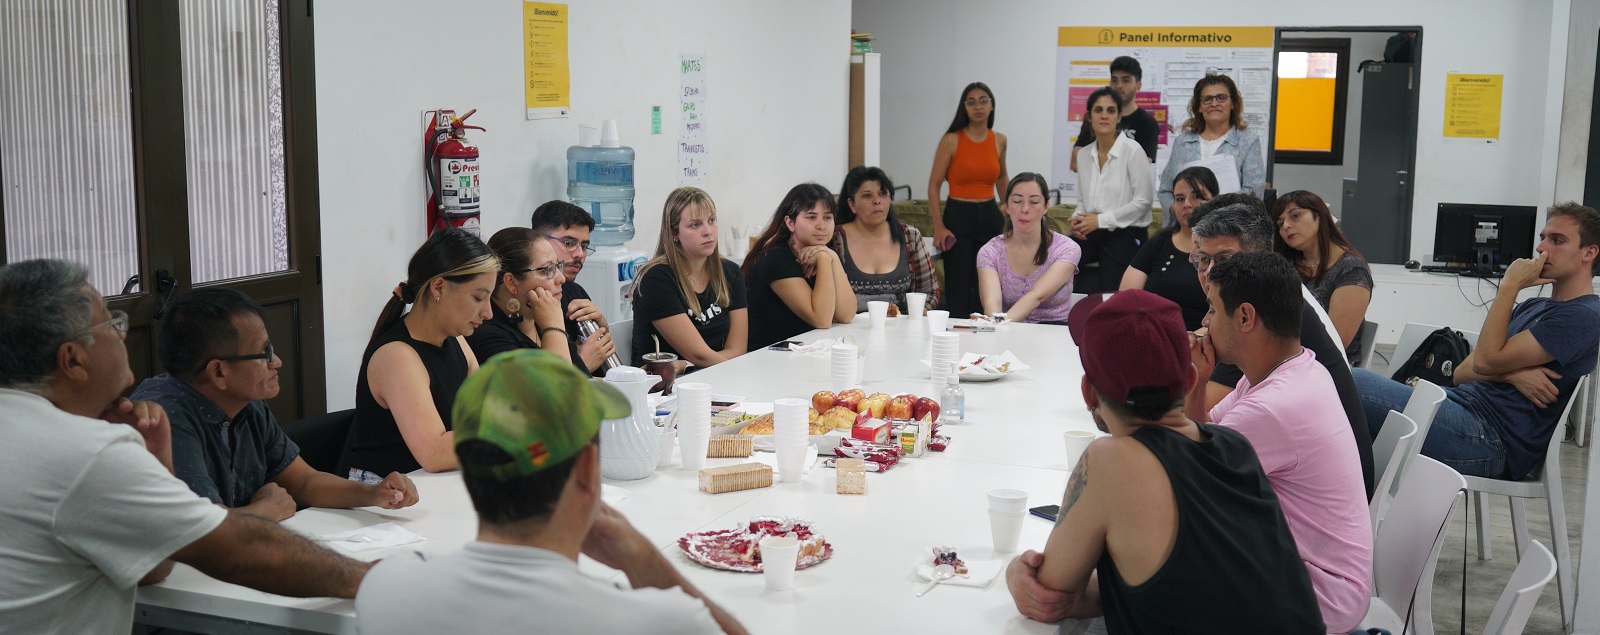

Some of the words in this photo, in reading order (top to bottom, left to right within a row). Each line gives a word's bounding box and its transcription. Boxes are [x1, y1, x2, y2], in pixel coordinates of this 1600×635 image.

[1119, 32, 1153, 43] Panel
[1158, 32, 1232, 43] Informativo
[681, 59, 701, 74] MARTES
[441, 115, 450, 127] A
[681, 142, 704, 154] TRAVESTIS
[683, 167, 698, 177] TRANS
